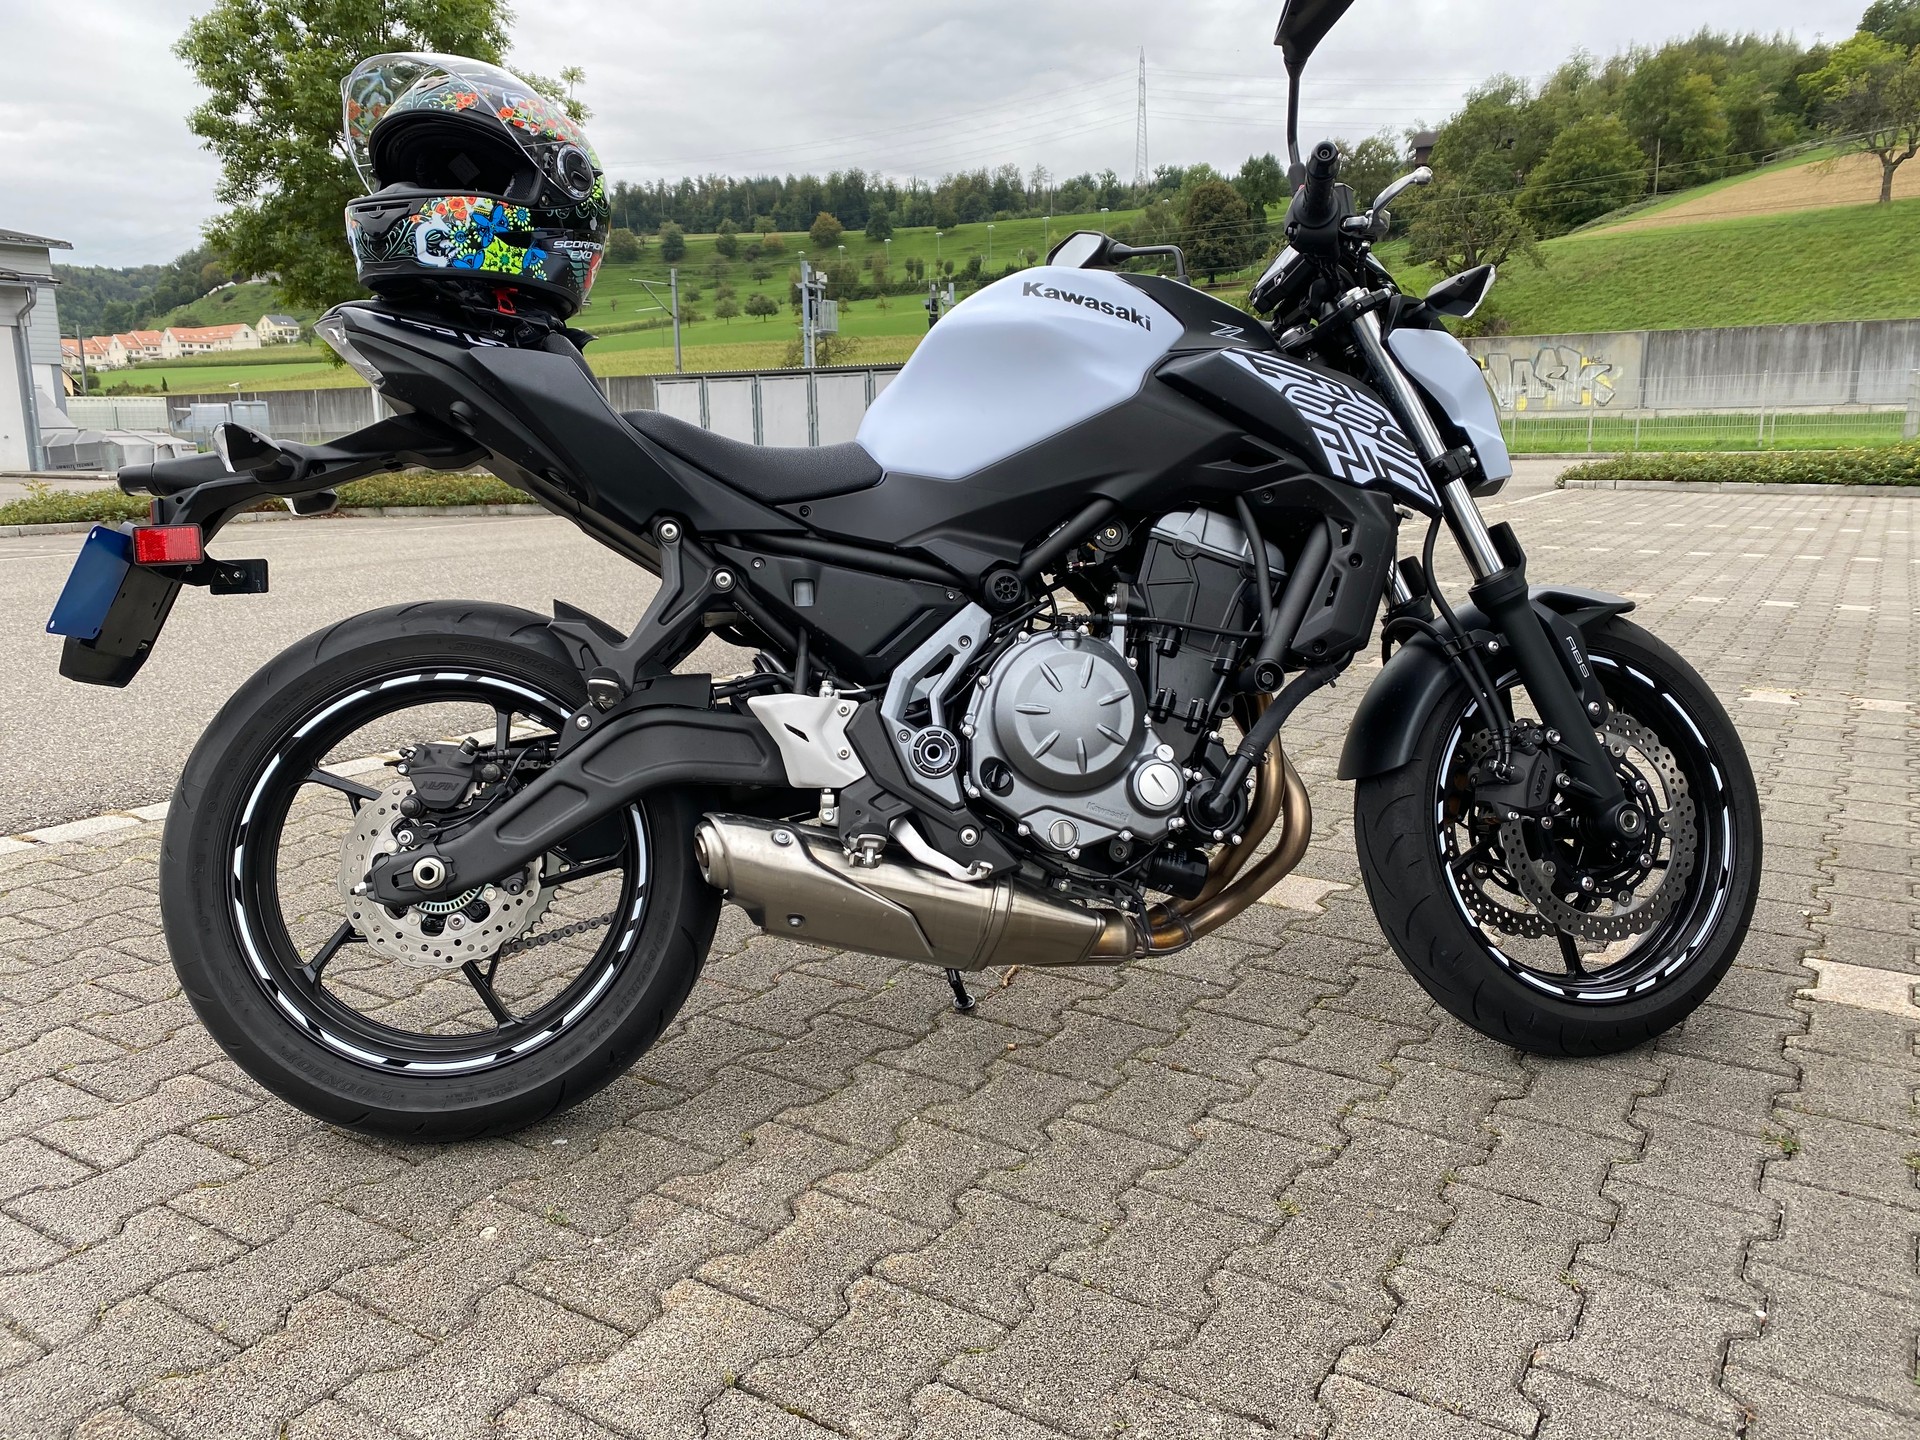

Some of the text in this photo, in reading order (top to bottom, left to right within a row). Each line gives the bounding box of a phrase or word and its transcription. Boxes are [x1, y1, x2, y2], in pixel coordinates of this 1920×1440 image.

[553, 240, 603, 250] SCORPION
[570, 250, 593, 260] EXO
[1022, 281, 1151, 332] Kawasaki
[1565, 635, 1590, 678] ABS
